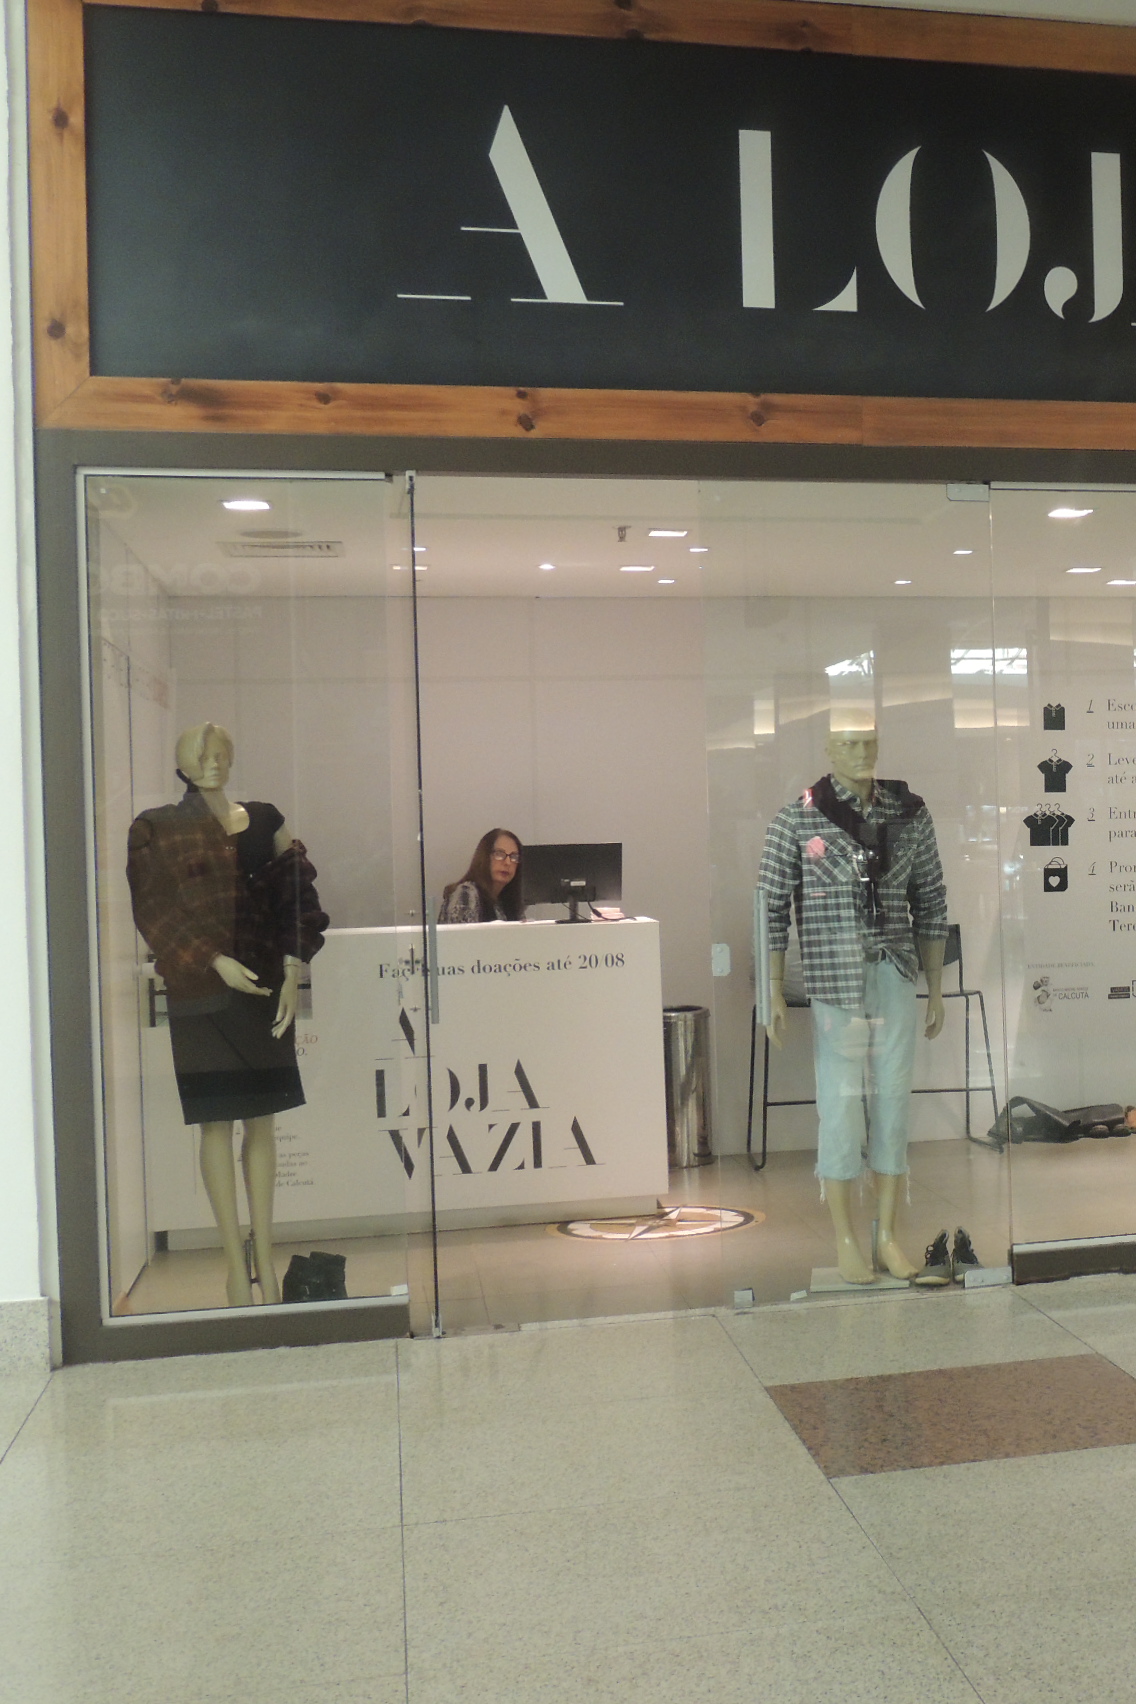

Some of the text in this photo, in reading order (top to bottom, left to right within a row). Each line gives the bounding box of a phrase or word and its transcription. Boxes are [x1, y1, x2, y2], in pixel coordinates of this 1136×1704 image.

[397, 104, 624, 306] A
[1107, 721, 1136, 730] uma
[1107, 771, 1127, 785] até
[1108, 829, 1136, 843] para
[471, 959, 541, 977] doações
[546, 955, 572, 971] até
[375, 1058, 550, 1119] LOJA
[378, 1116, 606, 1180] VAZIA
